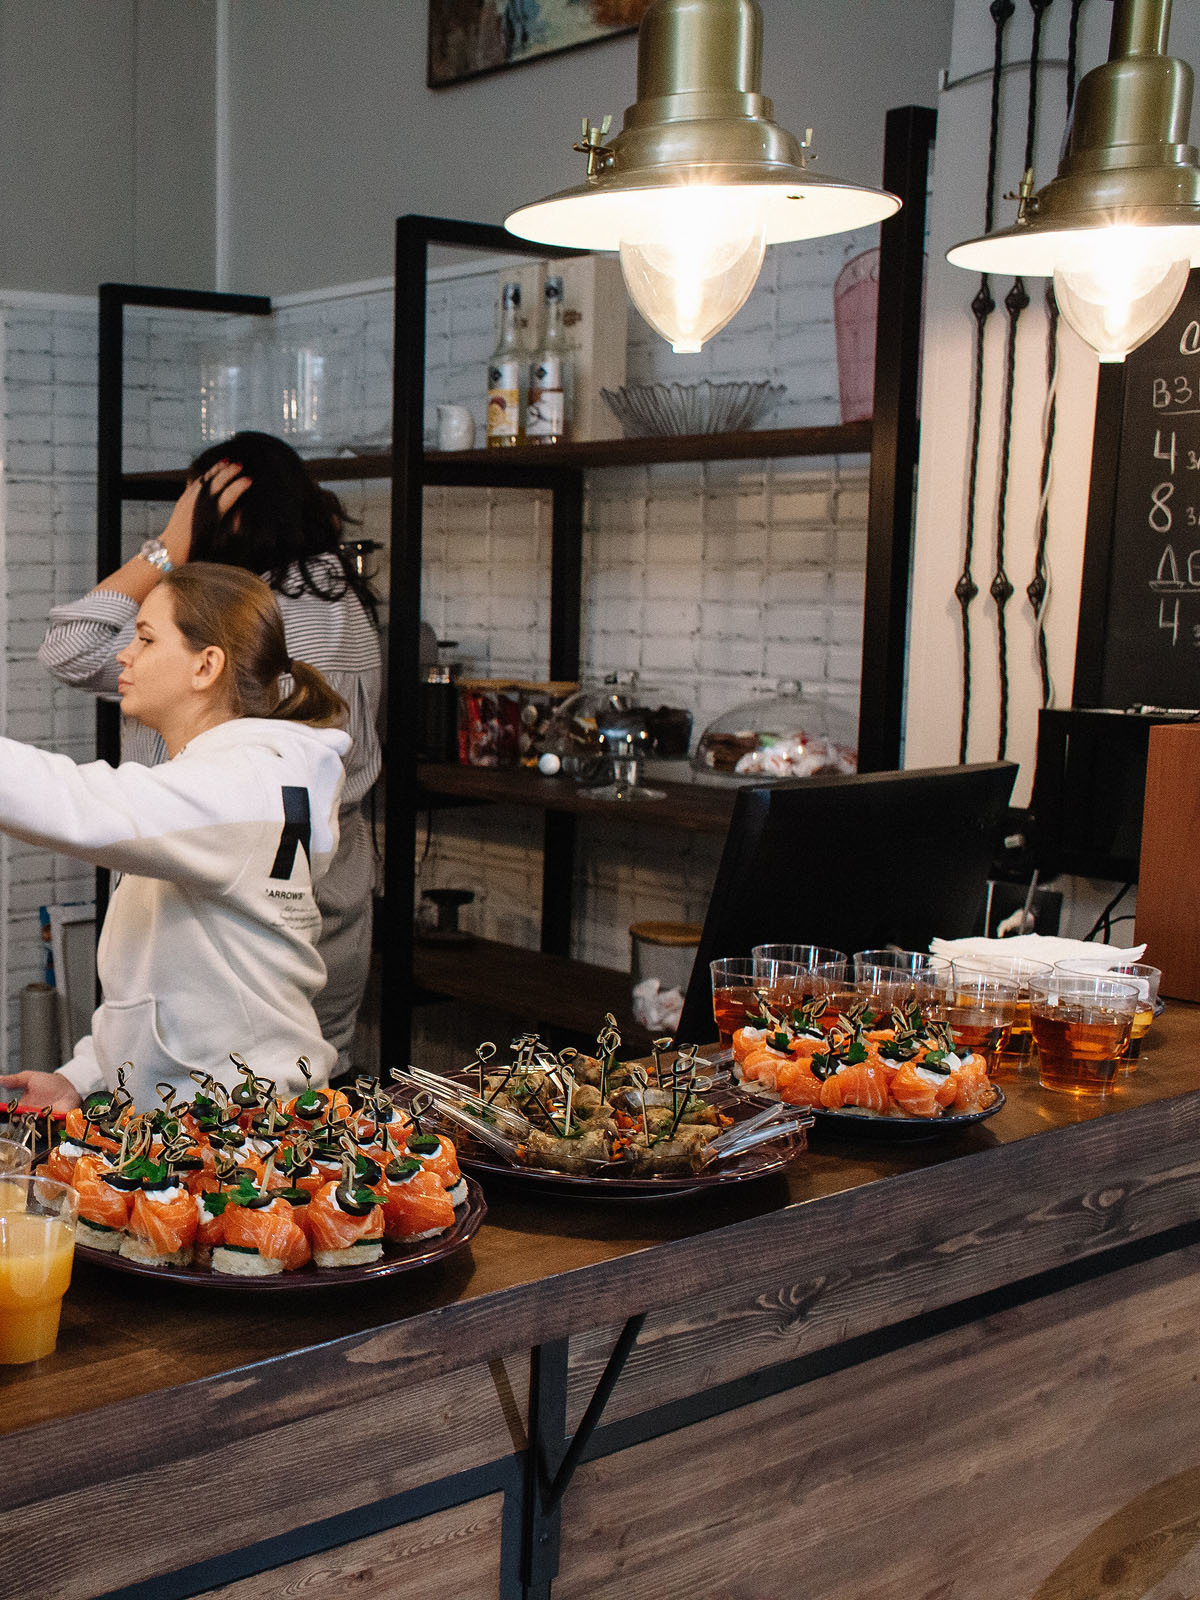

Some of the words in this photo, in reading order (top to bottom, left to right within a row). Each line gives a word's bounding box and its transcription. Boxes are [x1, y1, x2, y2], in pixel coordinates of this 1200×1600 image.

[1154, 429, 1178, 474] 4
[1149, 482, 1172, 532] 8
[1159, 598, 1179, 646] 4
